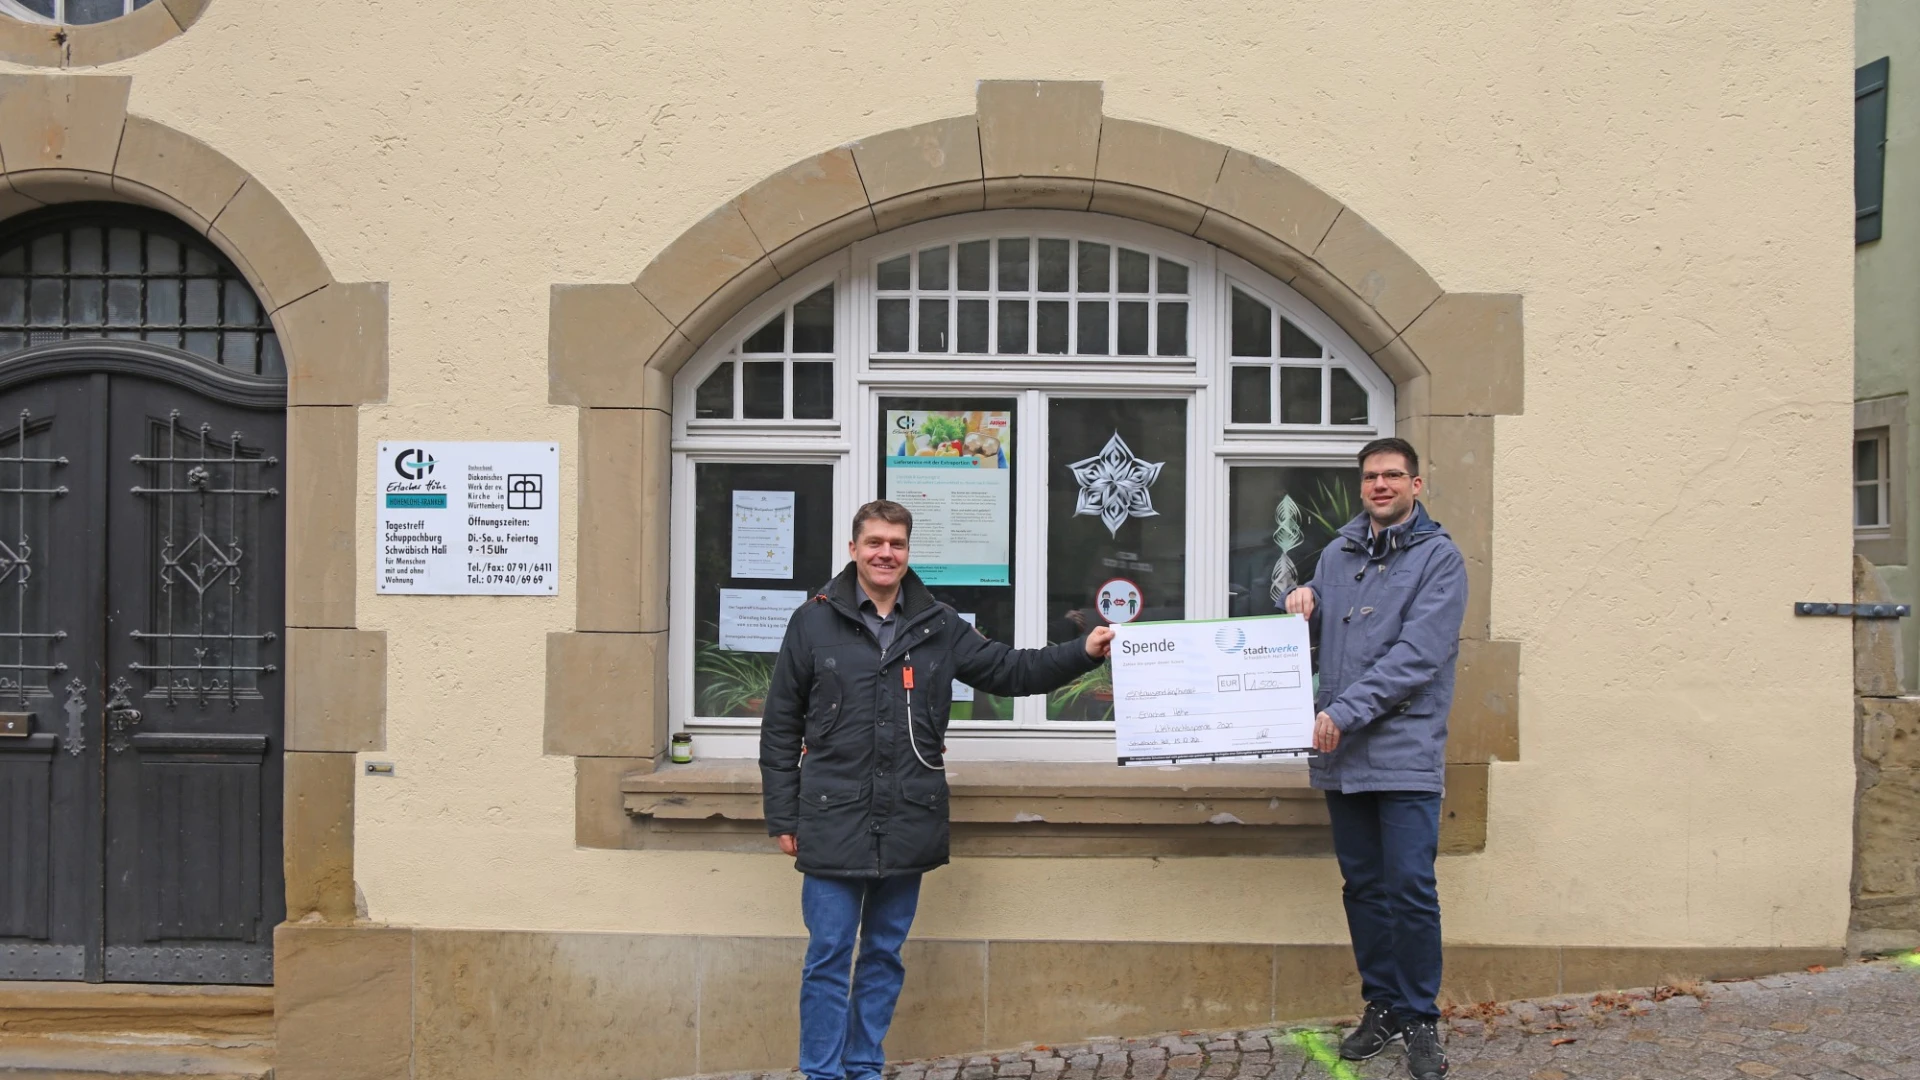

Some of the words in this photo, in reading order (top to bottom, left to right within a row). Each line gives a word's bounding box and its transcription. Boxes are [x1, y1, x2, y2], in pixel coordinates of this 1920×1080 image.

[386, 482, 421, 492] Erlacher
[426, 480, 447, 491] Höhe
[468, 502, 504, 511] Württemberg
[386, 520, 424, 532] Tagestreff
[468, 515, 529, 528] Öffnungszeiten:
[386, 533, 442, 544] Schuppachburg
[507, 534, 538, 545] Feiertag
[386, 545, 428, 554] Schwäbisch
[468, 563, 504, 573] Tel./Fax:
[386, 577, 413, 585] Wohnung
[468, 575, 484, 583] Tel.:
[1122, 638, 1175, 656] Spende
[1243, 644, 1298, 655] stadtwerke
[1221, 679, 1237, 687] EUR
